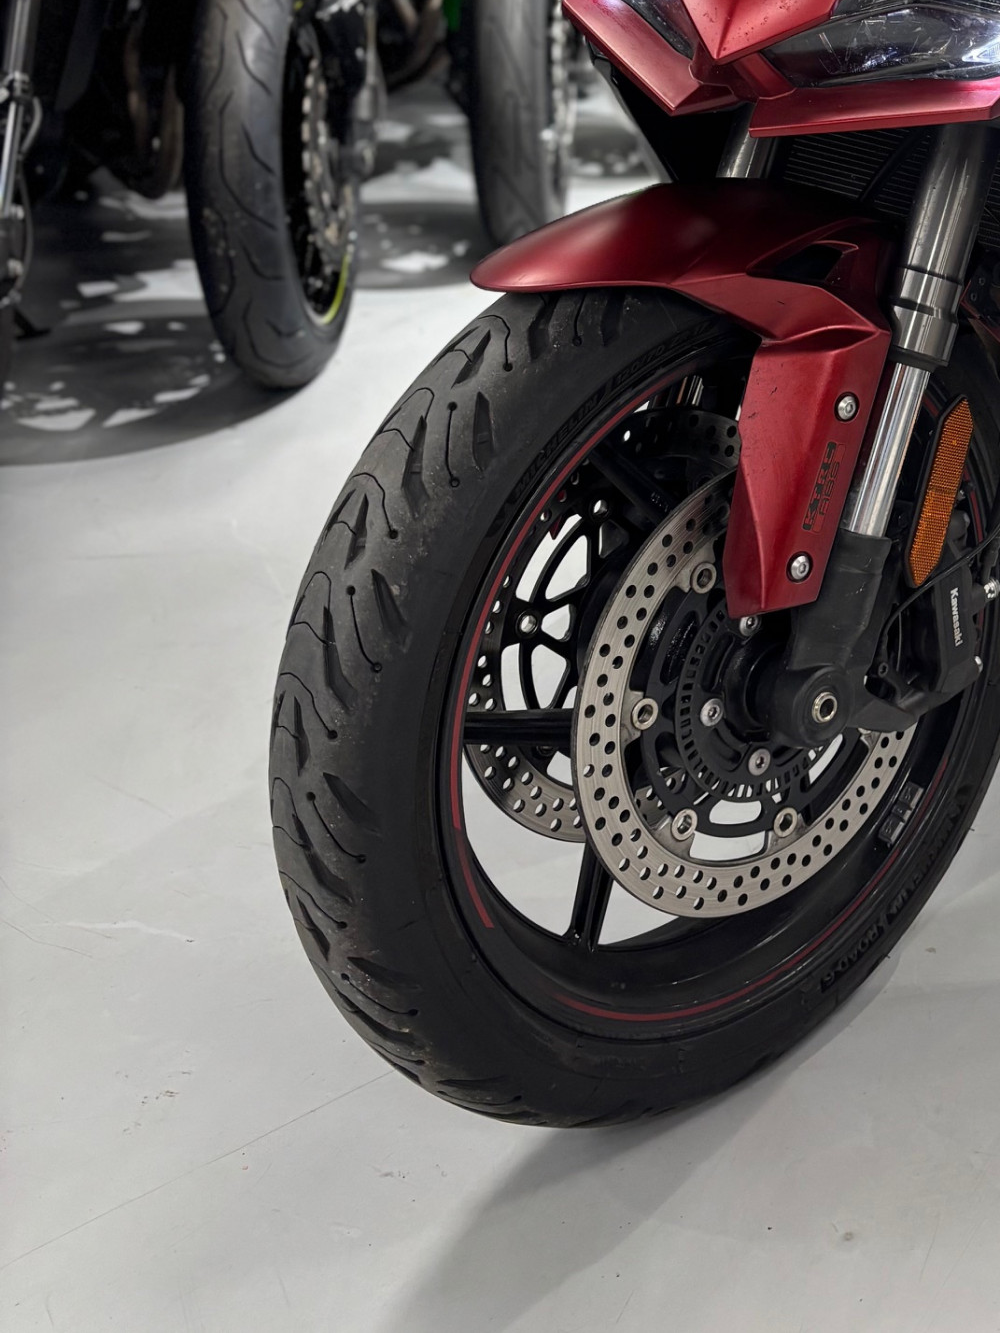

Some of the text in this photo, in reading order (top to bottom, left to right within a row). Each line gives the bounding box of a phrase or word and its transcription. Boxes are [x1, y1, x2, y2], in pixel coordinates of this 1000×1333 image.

[514, 393, 598, 494] MICHELIN
[950, 587, 963, 646] Kawasaki
[835, 923, 878, 970] ROAD
